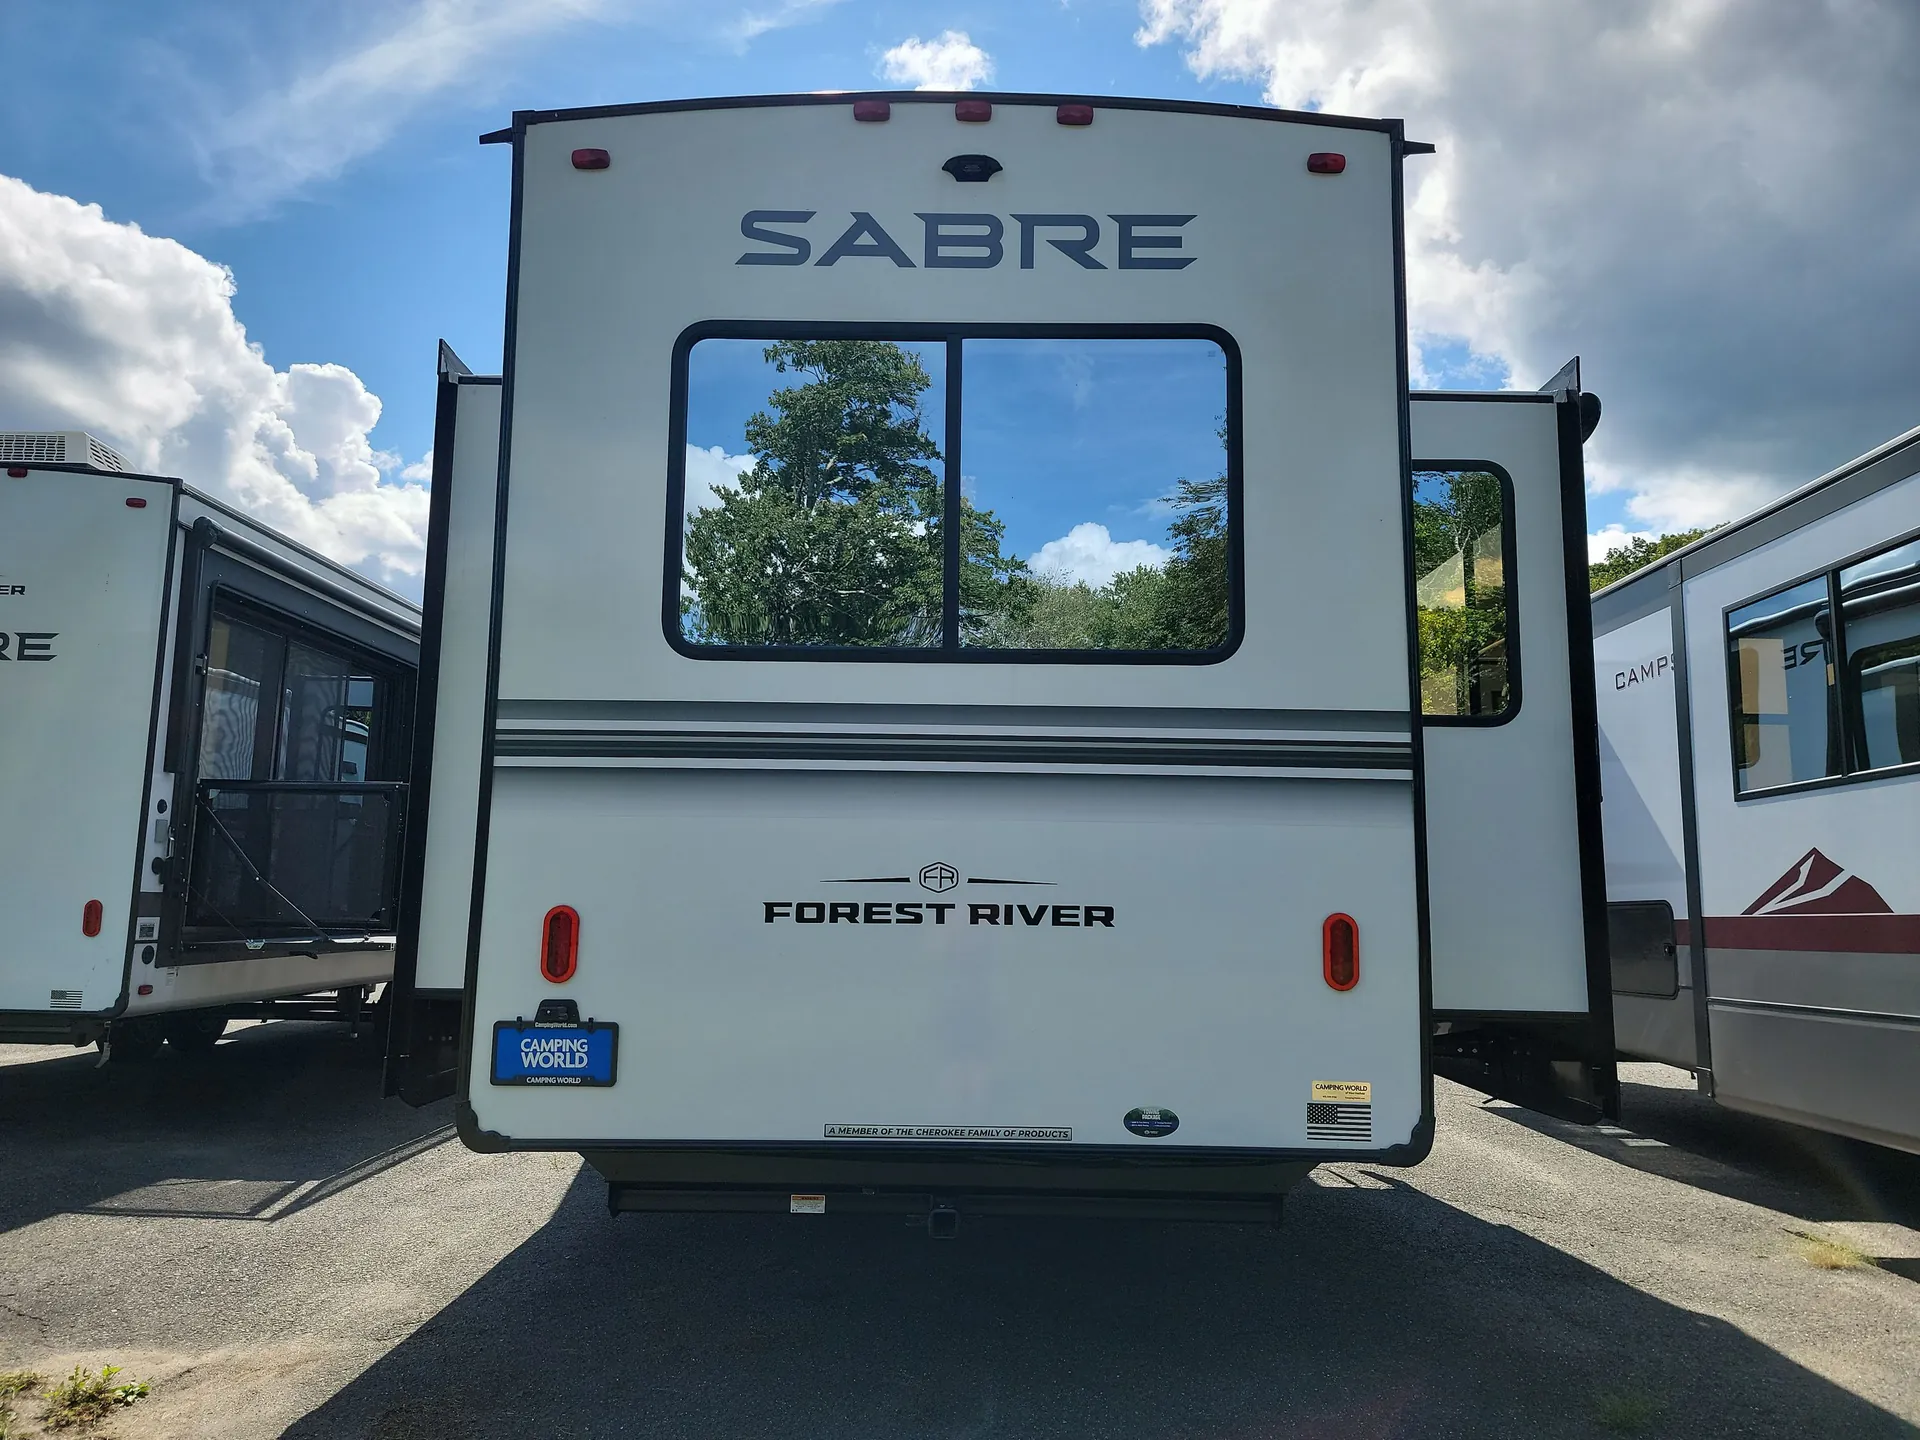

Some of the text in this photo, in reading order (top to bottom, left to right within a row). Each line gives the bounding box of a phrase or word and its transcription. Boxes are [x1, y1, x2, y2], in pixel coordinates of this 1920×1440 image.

[735, 209, 1198, 270] SABRE
[0, 631, 60, 662] E
[762, 901, 1116, 928] FOREST RIVER
[534, 1021, 578, 1029] CampingWorld.com
[520, 1038, 588, 1053] CAMPING
[520, 1051, 588, 1069] WORLD
[526, 1076, 581, 1085] CAMPING WORLD
[1315, 1083, 1344, 1091] CAMPING
[828, 1127, 1069, 1139] A MEMBER OF THE CHEROKEE FAMILY OF PRODUCTS
